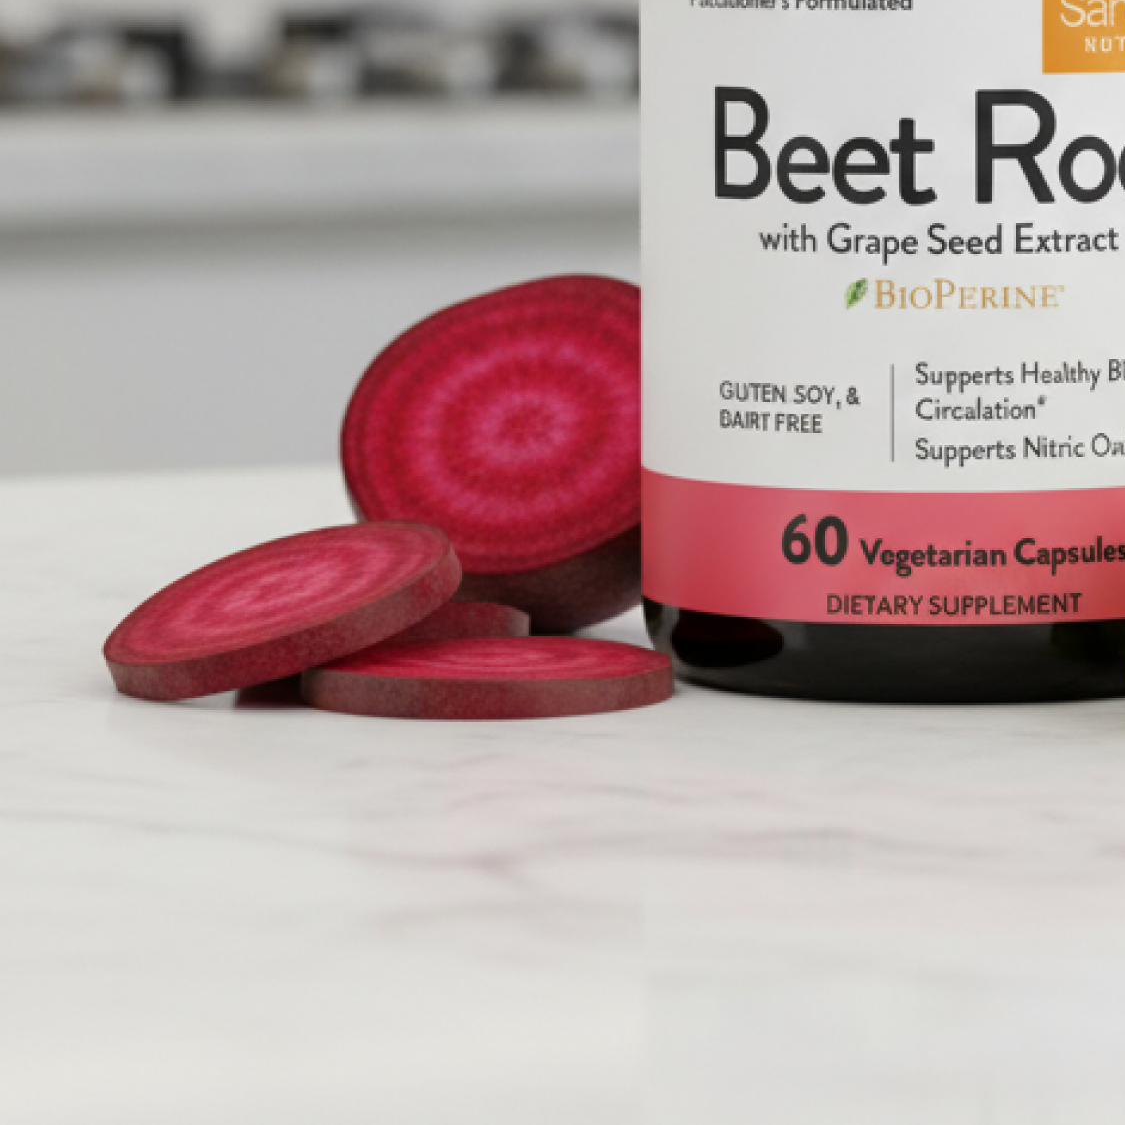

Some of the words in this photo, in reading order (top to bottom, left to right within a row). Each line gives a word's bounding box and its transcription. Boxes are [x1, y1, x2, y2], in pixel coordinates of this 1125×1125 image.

[714, 85, 938, 206] Beet
[758, 222, 818, 253] with
[826, 222, 919, 266] Grape
[926, 222, 1003, 256] Seed
[1015, 222, 1120, 255] Extract
[1020, 359, 1102, 392] Healthy
[846, 384, 862, 406] &
[774, 411, 824, 435] FREE
[1022, 434, 1085, 459] Nitric
[781, 513, 850, 567] 60
[826, 593, 924, 616] DIETARY
[929, 592, 1083, 617] SUPPLEMENT
